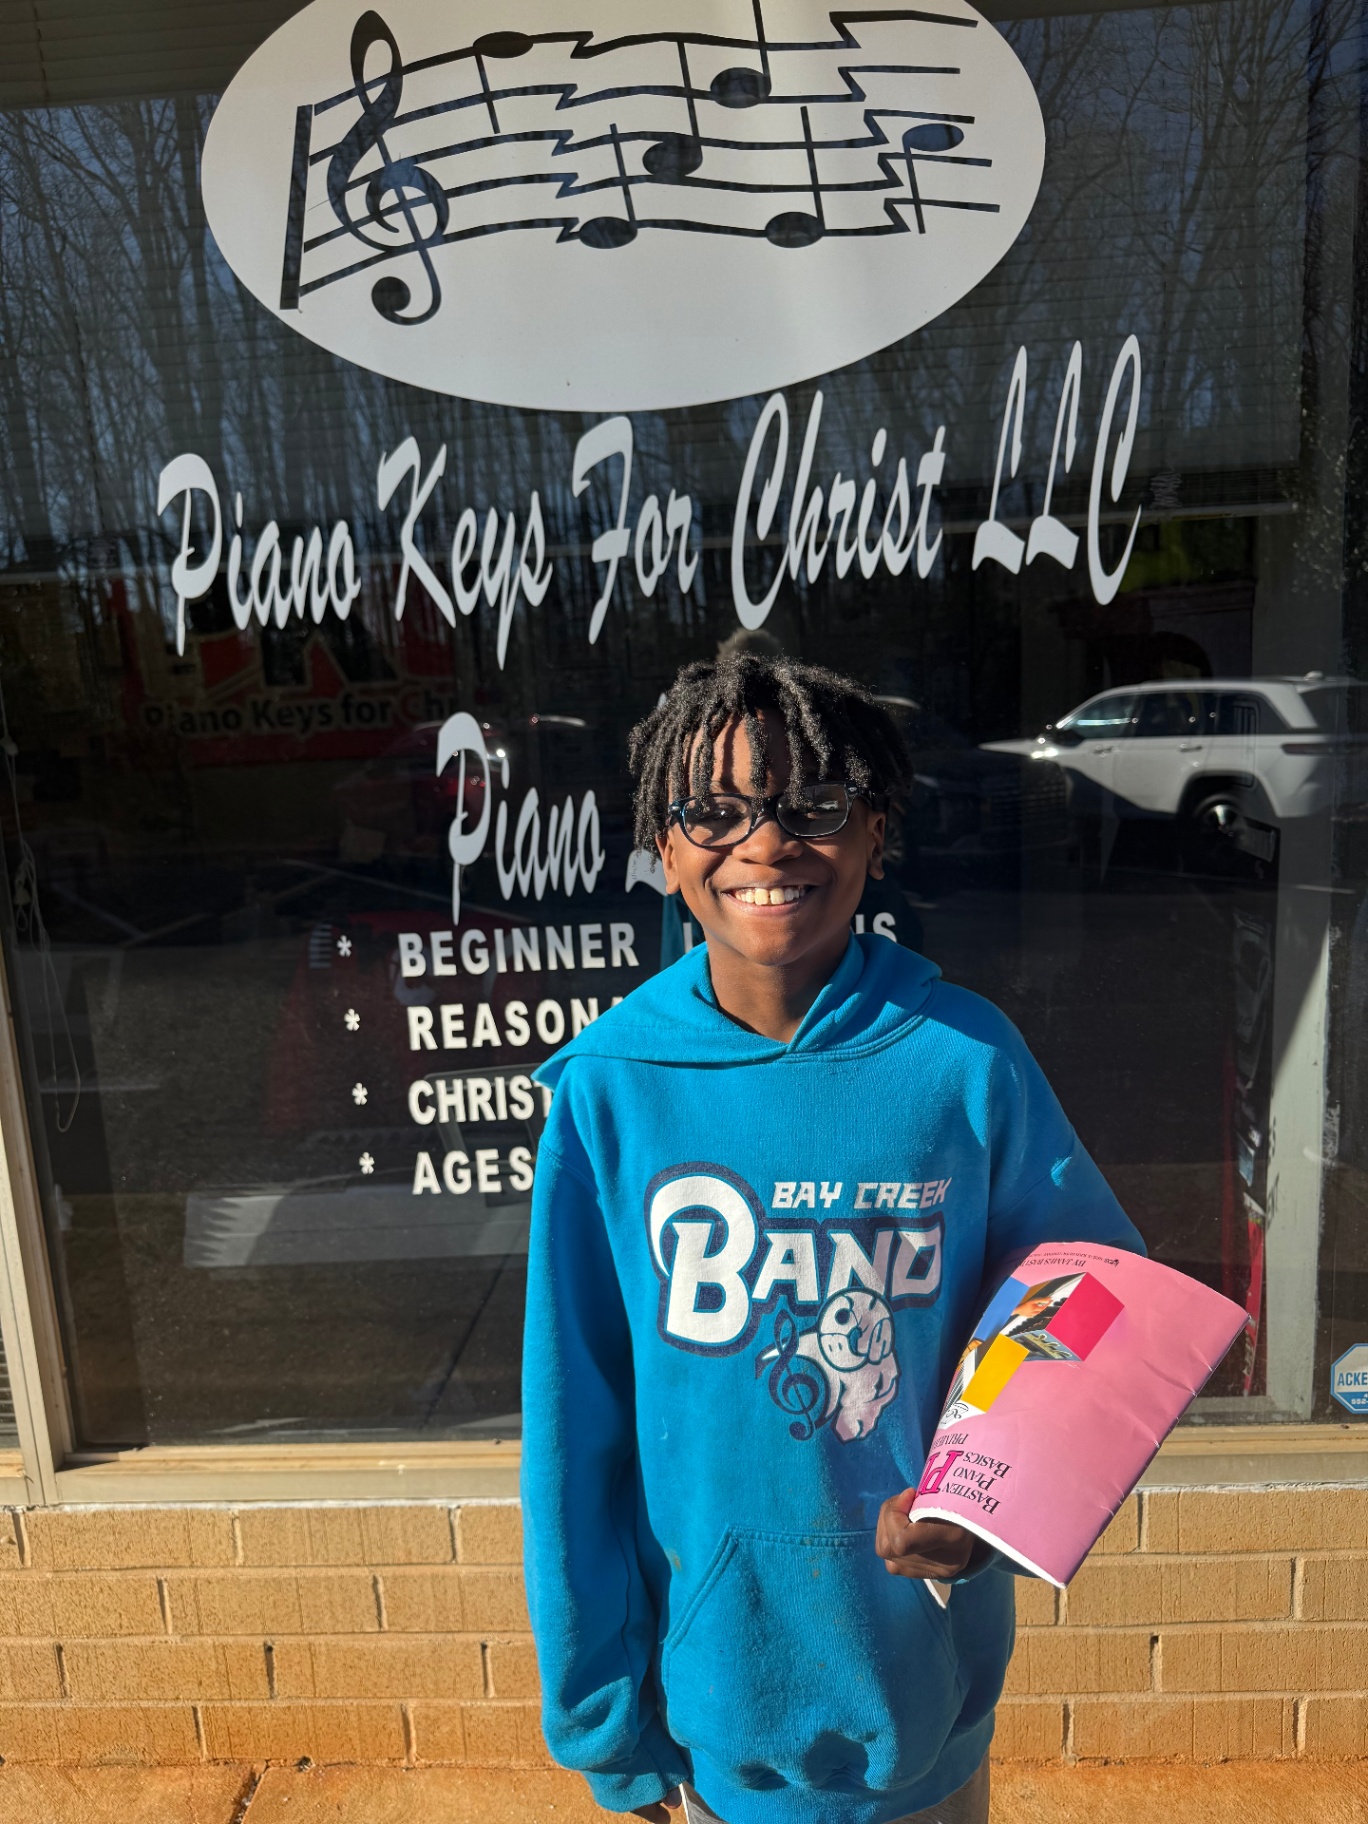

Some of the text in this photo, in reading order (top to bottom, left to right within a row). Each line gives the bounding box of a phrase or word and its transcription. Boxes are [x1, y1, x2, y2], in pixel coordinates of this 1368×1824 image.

[157, 334, 1143, 671] Piano Keys For Christ LLC
[251, 699, 332, 734] Keys
[341, 693, 391, 724] for
[436, 711, 606, 926] Piano
[397, 921, 640, 978] BEGINNER
[412, 1146, 535, 1196] AGES
[771, 1177, 953, 1210] BAY CREEK
[649, 1174, 942, 1344] BAND
[952, 1466, 998, 1491] PIANO
[962, 1451, 1013, 1479] BASICS
[942, 1482, 1001, 1515] BASTIEN
